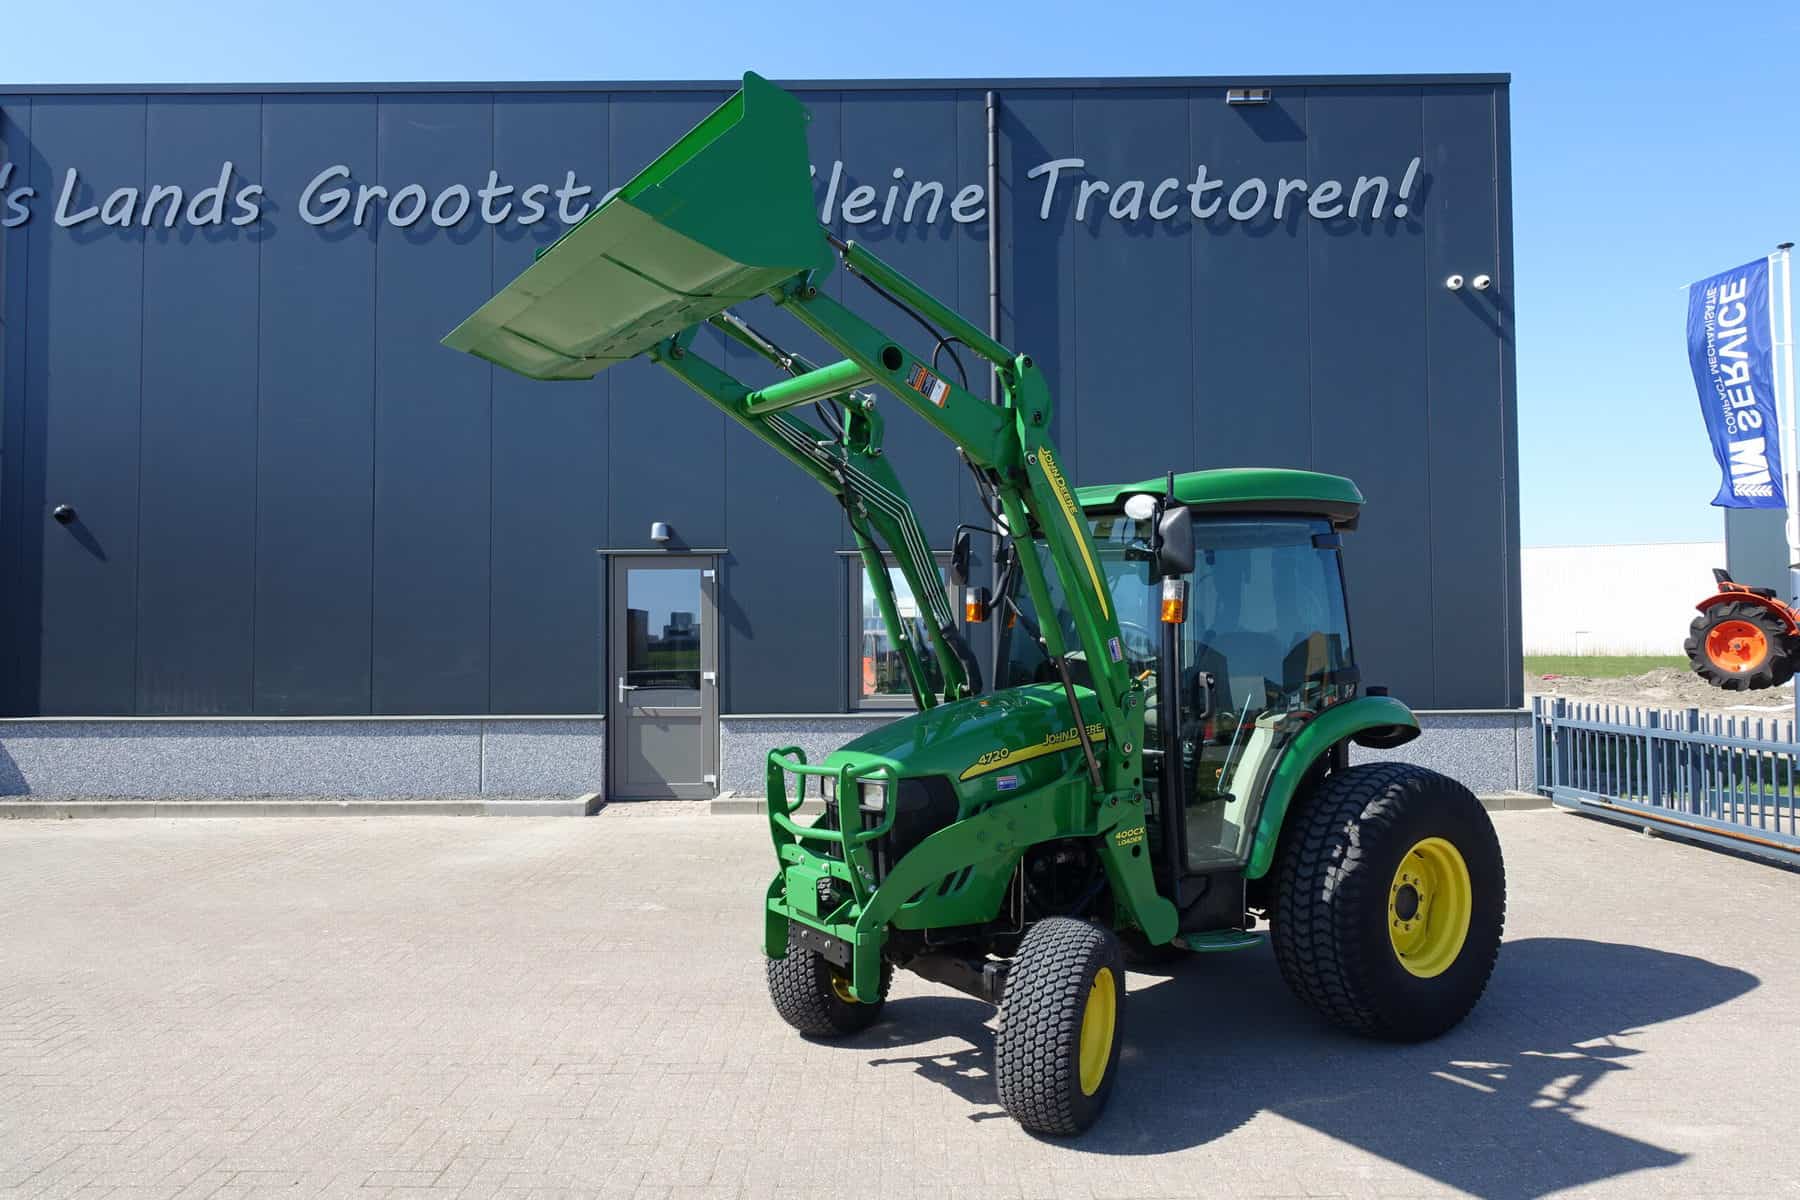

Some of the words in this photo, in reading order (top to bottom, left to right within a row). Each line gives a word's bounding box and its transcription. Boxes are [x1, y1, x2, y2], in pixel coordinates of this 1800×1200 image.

[55, 161, 262, 226] Lands
[809, 160, 986, 225] leine
[1027, 156, 1421, 221] Tractoren!
[1040, 447, 1061, 477] JOHN
[1043, 730, 1070, 745] JOHN
[1069, 722, 1103, 739] DERE
[979, 747, 1009, 765] 4720
